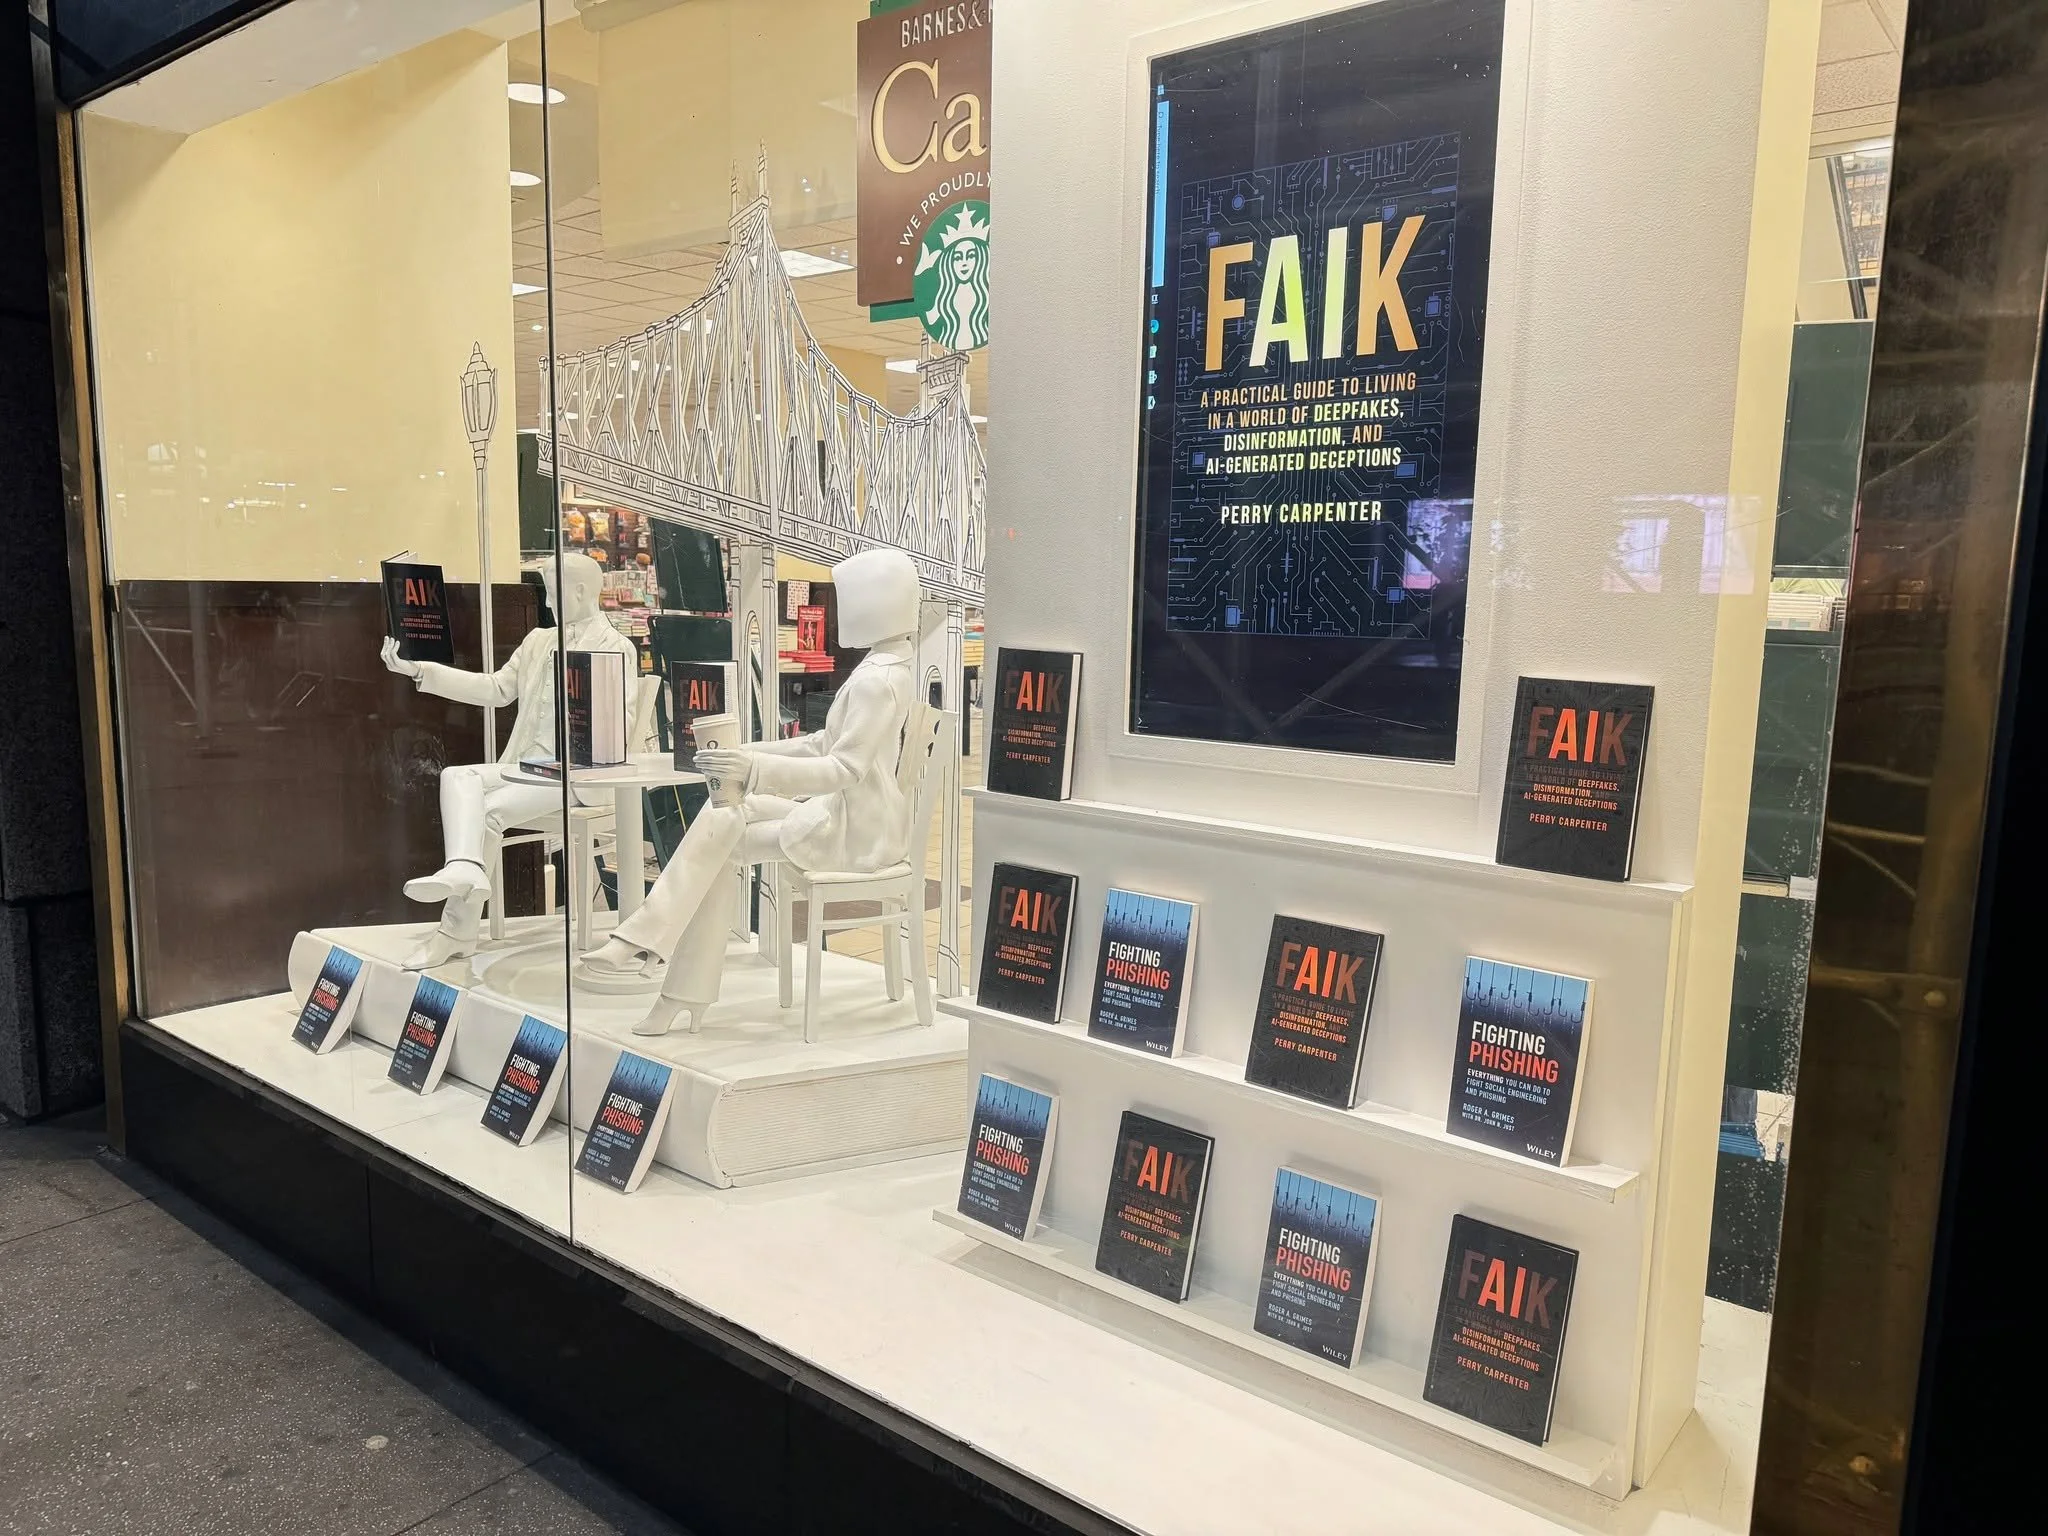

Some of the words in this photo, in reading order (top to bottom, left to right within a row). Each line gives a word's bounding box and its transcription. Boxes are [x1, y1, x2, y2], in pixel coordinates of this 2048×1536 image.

[901, 3, 965, 48] BARNES
[900, 215, 921, 246] WE
[1205, 215, 1426, 371] FAIK
[1200, 391, 1209, 408] A
[1214, 383, 1288, 407] PRACTICAL
[1293, 380, 1336, 401] GUIDE
[1341, 377, 1360, 396] TO
[1365, 372, 1417, 394] LIVING
[1208, 412, 1221, 430] IN
[1226, 411, 1234, 428] A
[1239, 408, 1287, 428] WORLD
[1291, 405, 1309, 424] OF
[1314, 397, 1404, 422] DEEPFAKES,
[1223, 427, 1347, 452] DISINFORMATION,
[1352, 424, 1383, 443] AND
[1206, 453, 1304, 475] AI-GENERATED
[1309, 447, 1401, 470] DECEPTIONS
[1221, 504, 1273, 524] PERRY
[1279, 501, 1382, 522] CARPENTER
[1003, 669, 1064, 713] FAIK
[1526, 705, 1634, 766] FAIK
[1532, 783, 1593, 798] DISINFORMATION,
[1577, 778, 1619, 791] DEEPFAKES,
[1523, 791, 1573, 805] AI-GENERATED
[1573, 797, 1617, 810] DECEPTIONS
[1529, 812, 1555, 824] PERRY
[1557, 816, 1607, 831] CARPENTER
[997, 885, 1062, 936] FAIK
[1108, 941, 1161, 967] FIGHTING
[997, 967, 1014, 977] PERRY
[1015, 971, 1045, 984] CARPENTER
[1105, 958, 1170, 990] PHISHING
[1276, 940, 1364, 1004] FAIK
[1103, 988, 1115, 996] FIGHT
[1116, 991, 1131, 1000] SOCIAL
[1131, 995, 1160, 1008] ENGINEERING
[1104, 980, 1129, 992] EVERYTHING
[1131, 987, 1139, 995] YOU
[1140, 989, 1149, 997] CAN
[410, 1011, 436, 1032] FIGHTING
[1099, 1009, 1114, 1019] ROGER
[1120, 1015, 1136, 1025] GRIMES
[1271, 1017, 1311, 1034] AI-GENERATED
[1311, 1027, 1346, 1043] DECEPTIONS
[1279, 1010, 1327, 1029] DISINFORMATION,
[1315, 1010, 1349, 1026] DEEPFAKES,
[405, 1022, 436, 1047] PHISHING
[1145, 1040, 1168, 1052] WILEY
[1471, 1020, 1545, 1056] FIGHTING
[1274, 1037, 1296, 1050] PERRY
[1297, 1043, 1337, 1061] CARPENTER
[1468, 1040, 1559, 1084] PHISHING
[510, 1053, 540, 1077] FIGHTING
[503, 1066, 540, 1094] PHISHING
[1466, 1076, 1483, 1088] FIGHT
[1484, 1081, 1506, 1094] SOCIAL
[1507, 1087, 1547, 1105] ENGINEERING
[1467, 1067, 1503, 1084] EVERYTHING
[1505, 1078, 1517, 1087] YOU
[1518, 1081, 1531, 1091] CAN
[1532, 1085, 1541, 1094] DO
[1542, 1087, 1550, 1096] TO
[606, 1092, 643, 1117] FIGHTING
[1464, 1086, 1477, 1096] AND
[1478, 1089, 1506, 1104] PHISHING
[600, 1105, 644, 1135] PHISHING
[1462, 1102, 1482, 1115] ROGER
[1483, 1108, 1490, 1117] A.
[1491, 1110, 1514, 1124] GRIMES
[978, 1123, 1023, 1154] FIGHTING
[1526, 1143, 1556, 1159] WILEY
[975, 1139, 1030, 1176] PHISHING
[1122, 1138, 1196, 1204] FAIK
[1117, 1210, 1150, 1229] AI-GENERATED
[1150, 1222, 1180, 1240] DECEPTIONS
[1154, 1207, 1182, 1224] DEEPFAKES,
[1120, 1229, 1138, 1243] PERRY
[1138, 1236, 1172, 1256] CARPENTER
[1278, 1227, 1341, 1265] FIGHTING
[1275, 1245, 1351, 1292] PHISHING
[1270, 1287, 1281, 1297] AND
[1282, 1291, 1306, 1307] PHISHING
[1272, 1278, 1287, 1290] FIGHT
[1287, 1284, 1306, 1297] SOCIAL
[1306, 1292, 1340, 1310] ENGINEERING
[1273, 1270, 1304, 1288] EVERYTHING
[1306, 1282, 1315, 1292] YOU
[1316, 1286, 1327, 1296] CAN
[1328, 1291, 1335, 1300] DO
[1336, 1294, 1343, 1303] TO
[1457, 1248, 1559, 1329] FAIK
[1268, 1302, 1285, 1315] ROGER
[1285, 1309, 1292, 1318] A.
[1292, 1312, 1312, 1326] GRIMES
[1322, 1345, 1347, 1362] WILEY
[1452, 1332, 1498, 1356] AI-GENERATED
[1499, 1349, 1539, 1371] DECEPTIONS
[1461, 1326, 1517, 1354] DISINFORMATION,
[1503, 1331, 1542, 1353] DEEPFAKES,
[1456, 1355, 1481, 1372] PERRY
[1483, 1365, 1529, 1390] CARPENTER
